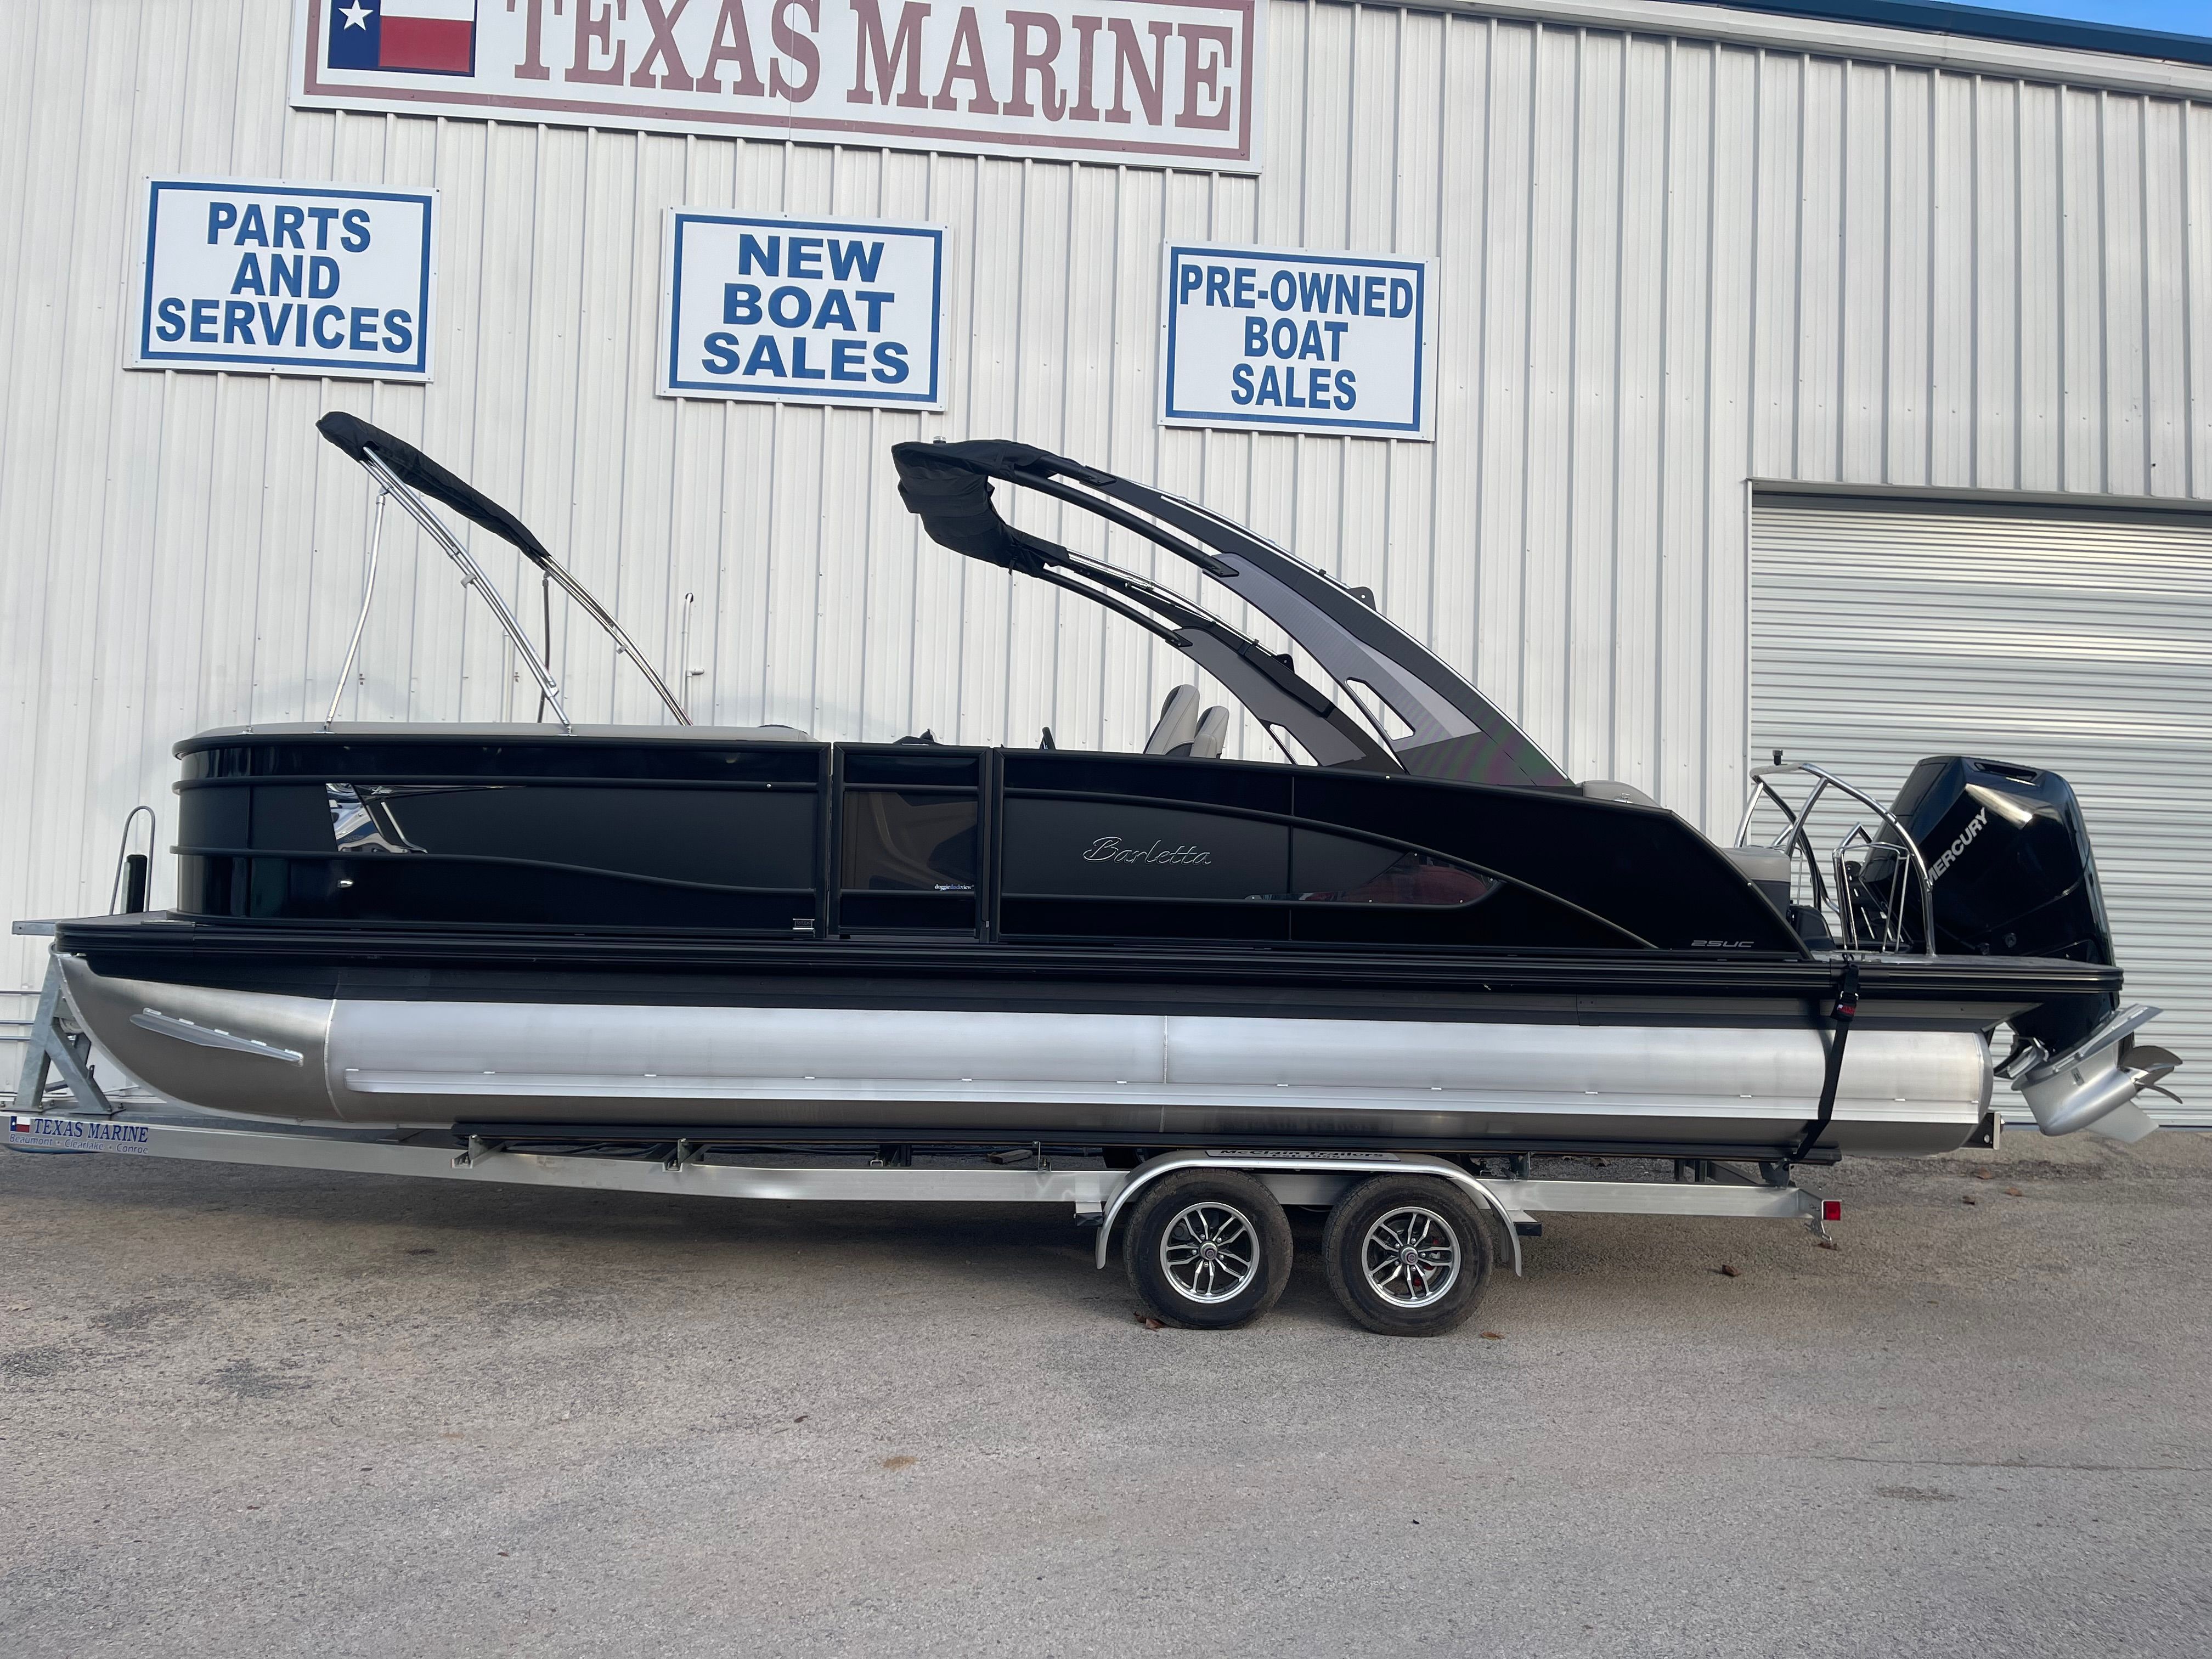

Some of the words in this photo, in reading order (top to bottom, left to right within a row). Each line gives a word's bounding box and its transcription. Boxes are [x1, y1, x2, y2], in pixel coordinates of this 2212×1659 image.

[506, 0, 820, 103] TEXAS
[847, 0, 1233, 131] MARINE
[207, 201, 371, 253] PARTS
[230, 252, 340, 299] AND
[738, 233, 885, 283] NEW
[723, 283, 895, 333] BOAT
[1180, 263, 1414, 319] PRE-OWNED
[155, 297, 413, 353] SERVICES
[1244, 315, 1349, 363] BOAT
[701, 331, 910, 384] SALES
[1231, 363, 1357, 411] SALES
[1082, 836, 1212, 866] Barletta
[9, 1133, 53, 1146] Beaumont
[64, 1139, 104, 1150] Clearlake
[116, 1143, 148, 1154] Conroe
[35, 1118, 83, 1137] TEXAS
[88, 1123, 149, 1143] MARINE
